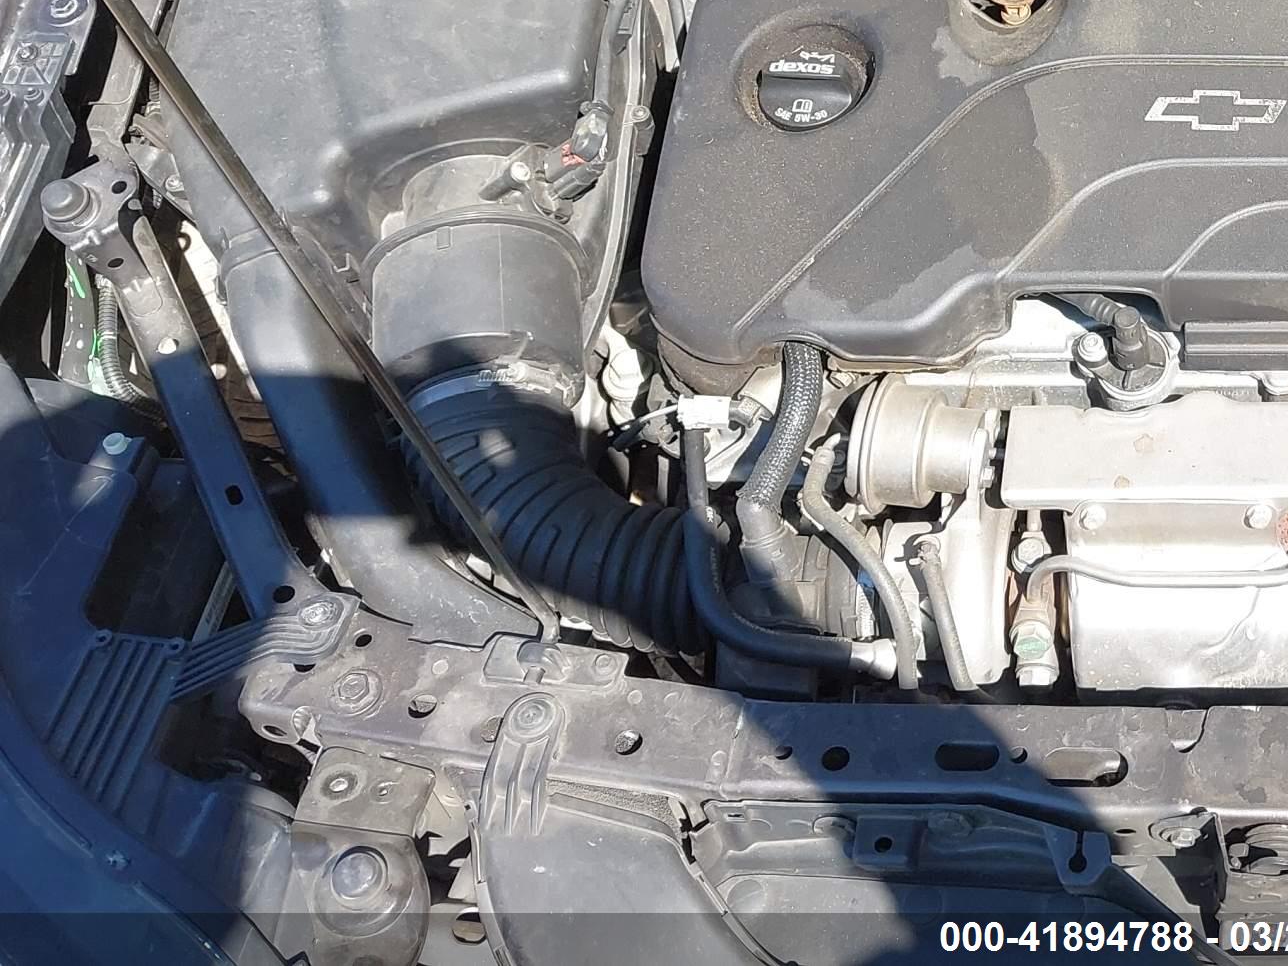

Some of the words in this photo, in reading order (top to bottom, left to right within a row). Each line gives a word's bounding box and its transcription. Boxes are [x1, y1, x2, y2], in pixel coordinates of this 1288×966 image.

[769, 59, 835, 75] dexos
[774, 107, 793, 121] SAE
[794, 110, 828, 122] 5W-30
